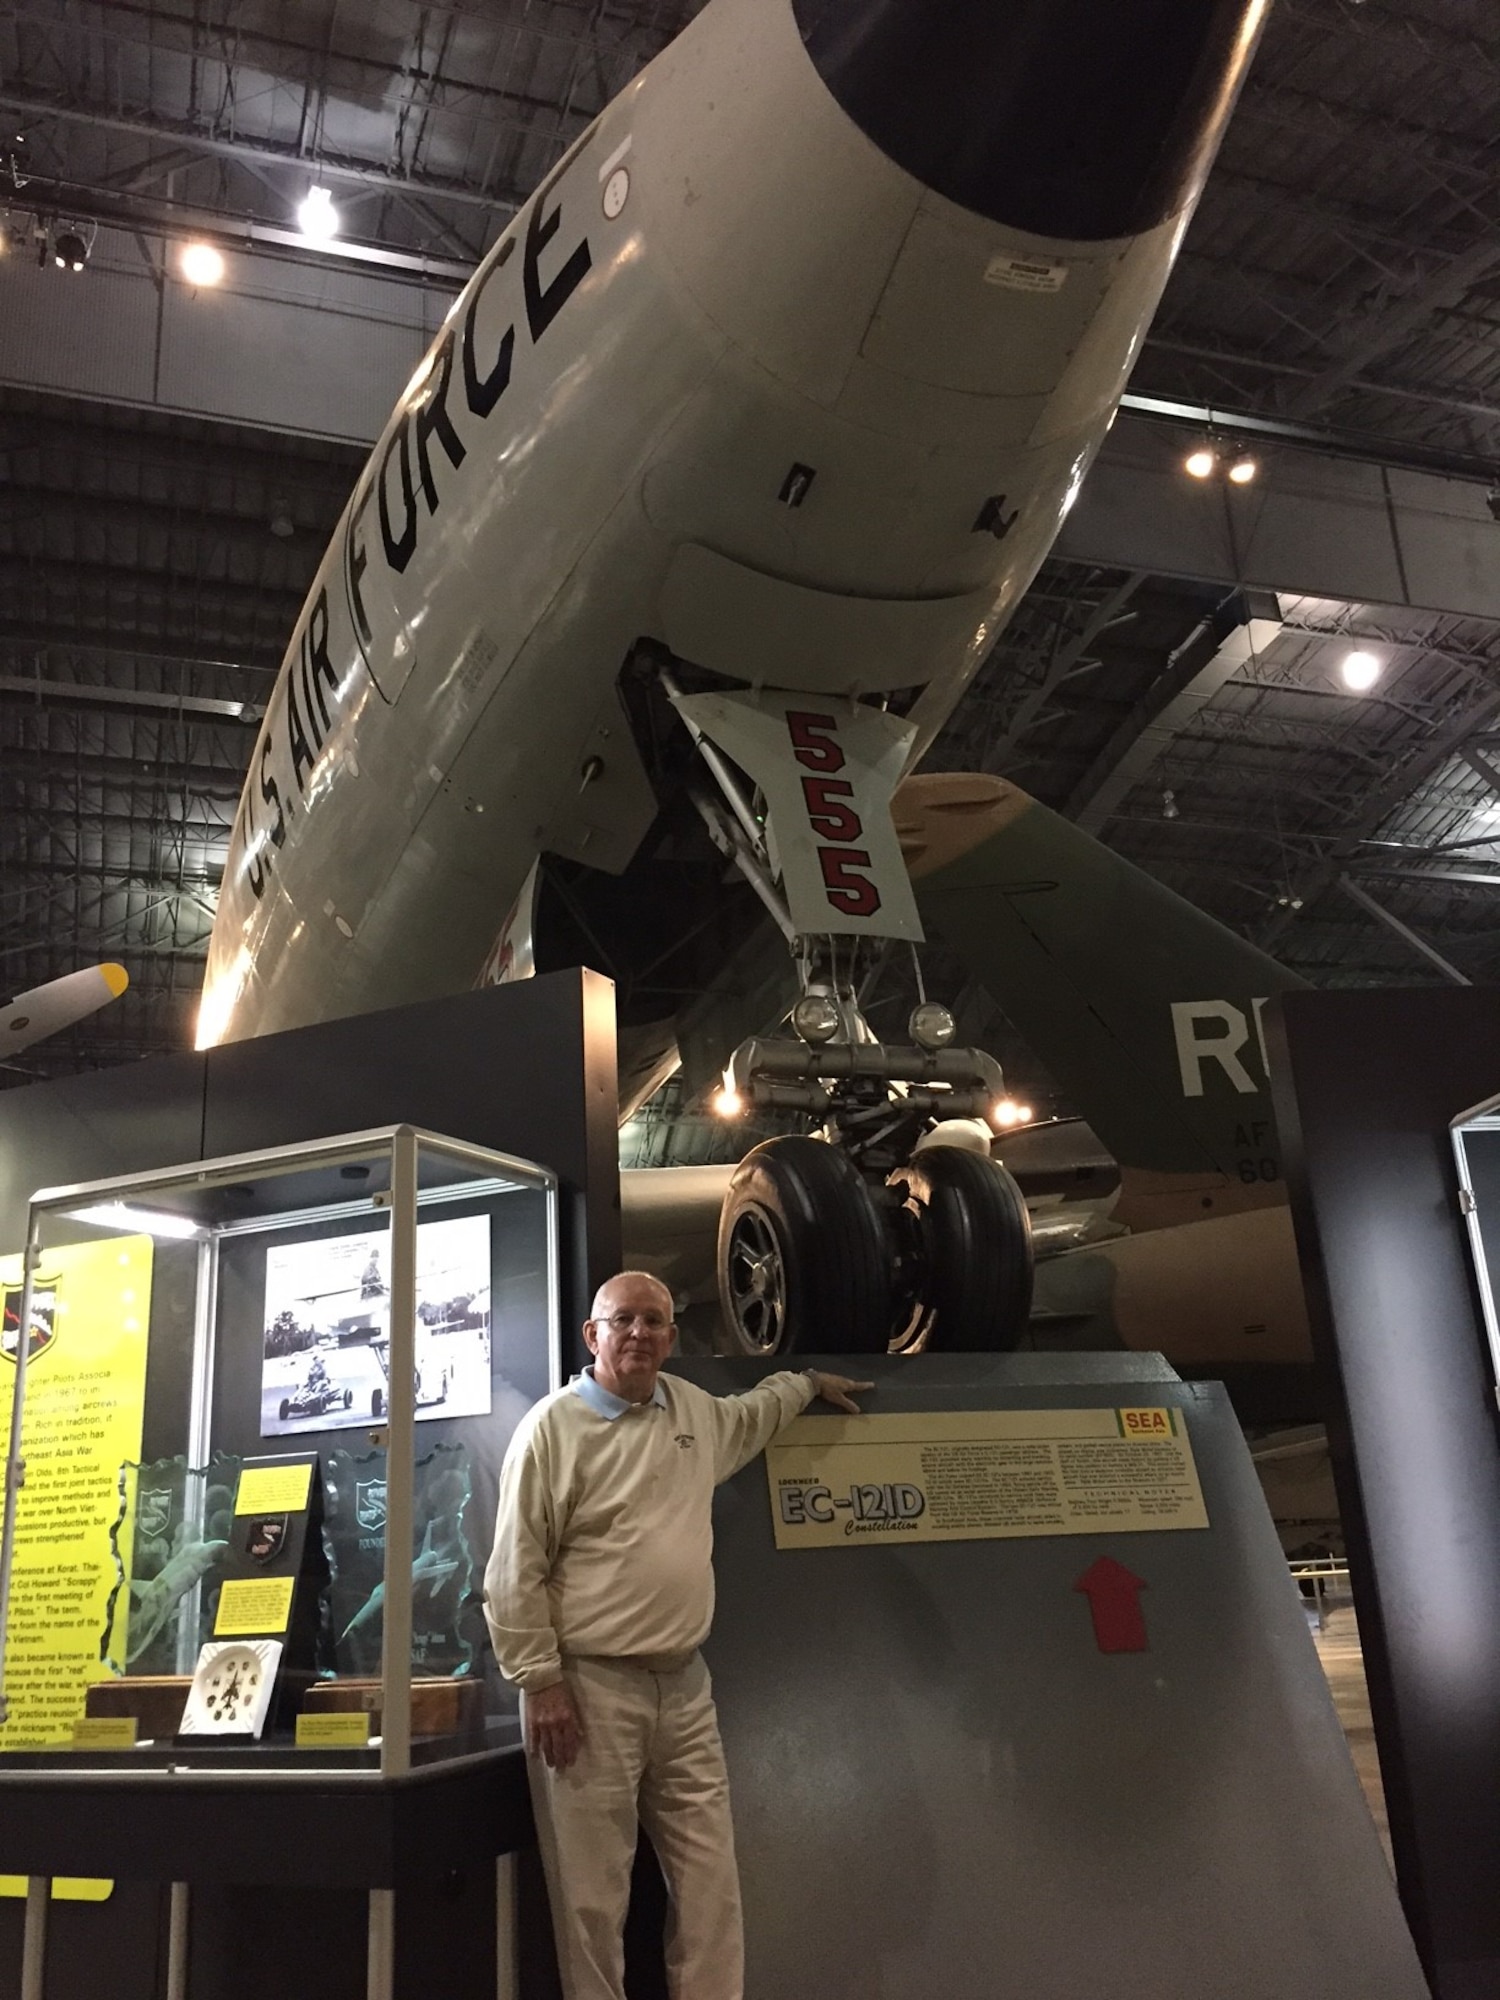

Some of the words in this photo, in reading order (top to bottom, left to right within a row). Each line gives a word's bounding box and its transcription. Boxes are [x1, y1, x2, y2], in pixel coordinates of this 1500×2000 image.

[288, 584, 339, 793] AIR
[348, 116, 602, 643] FORCE
[1170, 997, 1272, 1097] R
[1235, 1121, 1270, 1147] AF
[82, 1399, 118, 1410] aircrews
[35, 1420, 52, 1430] Rich
[1126, 1412, 1166, 1428] SEA
[62, 1431, 87, 1442] which
[90, 1429, 105, 1439] has
[55, 1448, 73, 1458] Asia
[77, 1445, 93, 1455] War
[73, 1463, 100, 1474] Tactical
[39, 1481, 51, 1489] the
[53, 1479, 67, 1488] first
[69, 1479, 85, 1489] joint
[88, 1477, 112, 1486] tactics
[31, 1494, 60, 1505] improve
[62, 1490, 94, 1500] methods
[97, 1488, 111, 1498] and
[779, 1482, 926, 1524] EC-121D
[38, 1509, 54, 1517] over
[56, 1505, 77, 1515] North
[93, 1516, 107, 1525] but
[844, 1518, 919, 1536] Constellation
[36, 1531, 85, 1544] strengthened
[31, 1579, 60, 1588] Howard
[21, 1593, 33, 1602] the
[36, 1592, 51, 1602] first
[52, 1591, 83, 1602] meeting
[85, 1590, 94, 1600] of
[46, 1605, 59, 1614] The
[20, 1621, 37, 1629] from
[39, 1620, 51, 1629] the
[53, 1620, 74, 1629] name
[76, 1618, 85, 1627] of
[87, 1617, 100, 1627] the
[10, 1654, 24, 1662] also
[26, 1653, 56, 1662] became
[58, 1651, 84, 1661] known
[86, 1652, 95, 1660] as
[33, 1667, 45, 1676] the
[48, 1666, 63, 1675] first
[5, 1683, 24, 1691] place
[26, 1682, 42, 1690] after
[44, 1681, 56, 1690] the
[30, 1695, 43, 1704] The
[46, 1696, 77, 1704] success
[7, 1724, 18, 1732] the
[20, 1723, 56, 1732] nickname
